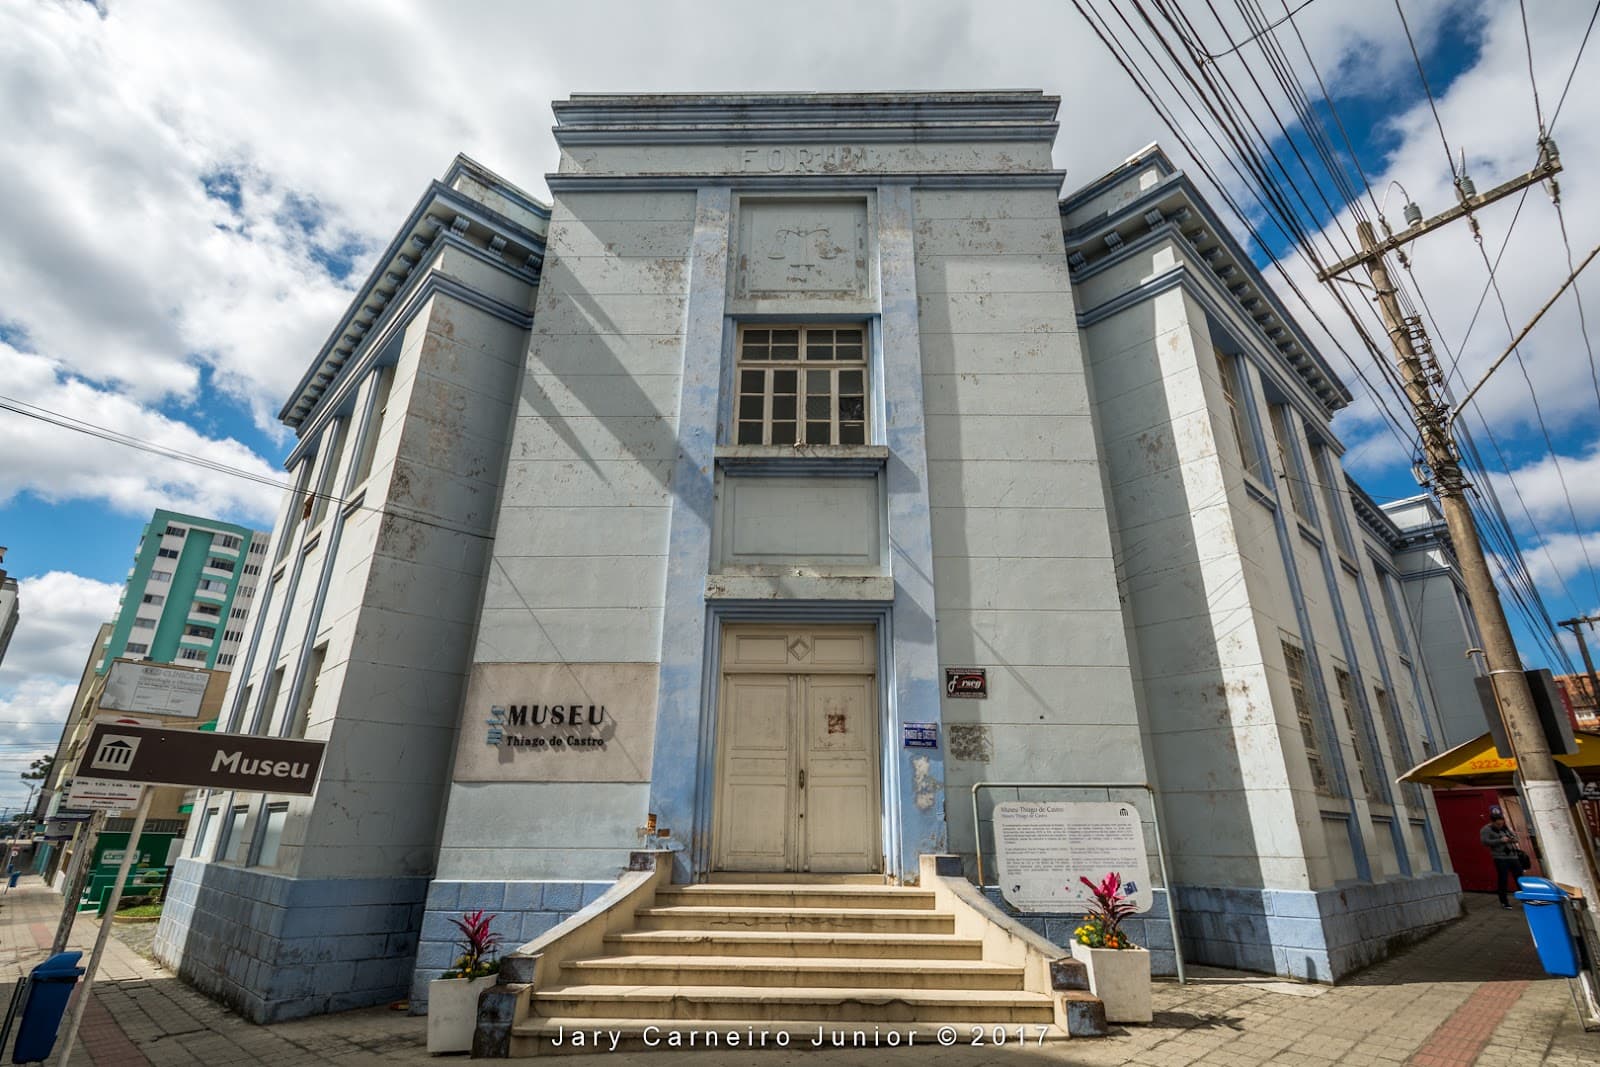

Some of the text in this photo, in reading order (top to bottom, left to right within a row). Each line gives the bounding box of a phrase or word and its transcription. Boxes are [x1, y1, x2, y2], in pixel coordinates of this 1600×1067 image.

[508, 704, 605, 726] MUSEU
[507, 735, 604, 747] Thiago de Castro
[210, 750, 310, 779] Museu
